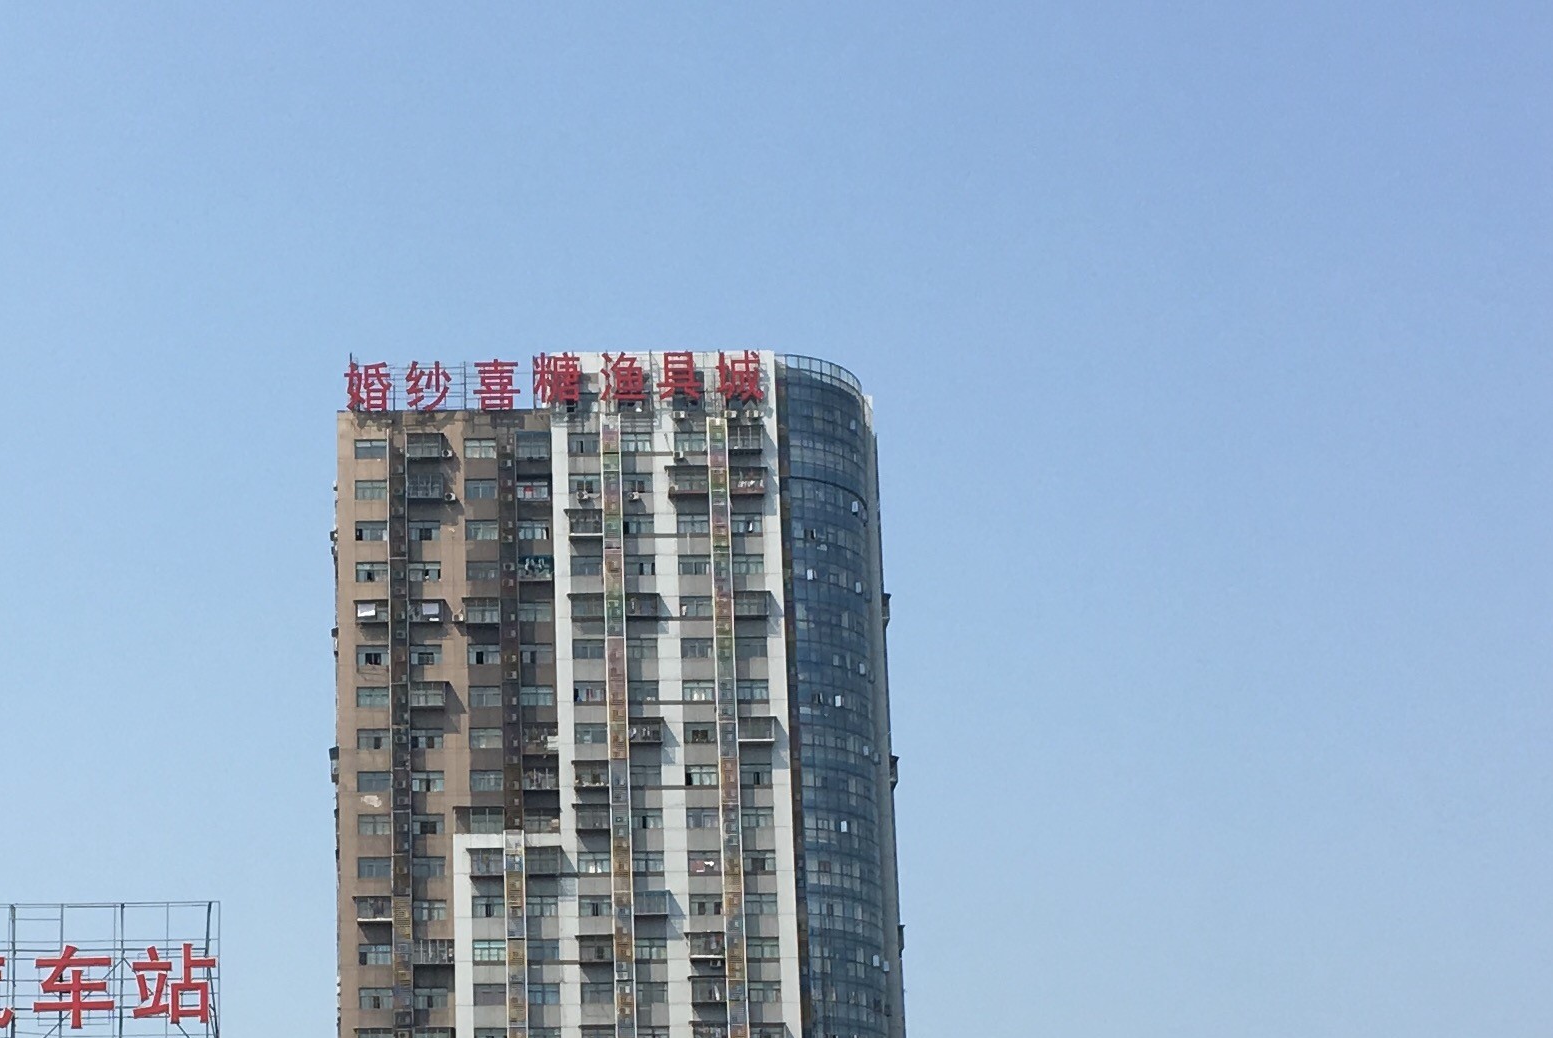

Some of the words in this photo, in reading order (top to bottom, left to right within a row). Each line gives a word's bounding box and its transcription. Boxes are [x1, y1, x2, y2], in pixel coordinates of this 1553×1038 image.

[344, 350, 765, 411] 婚纱喜糖渔具城
